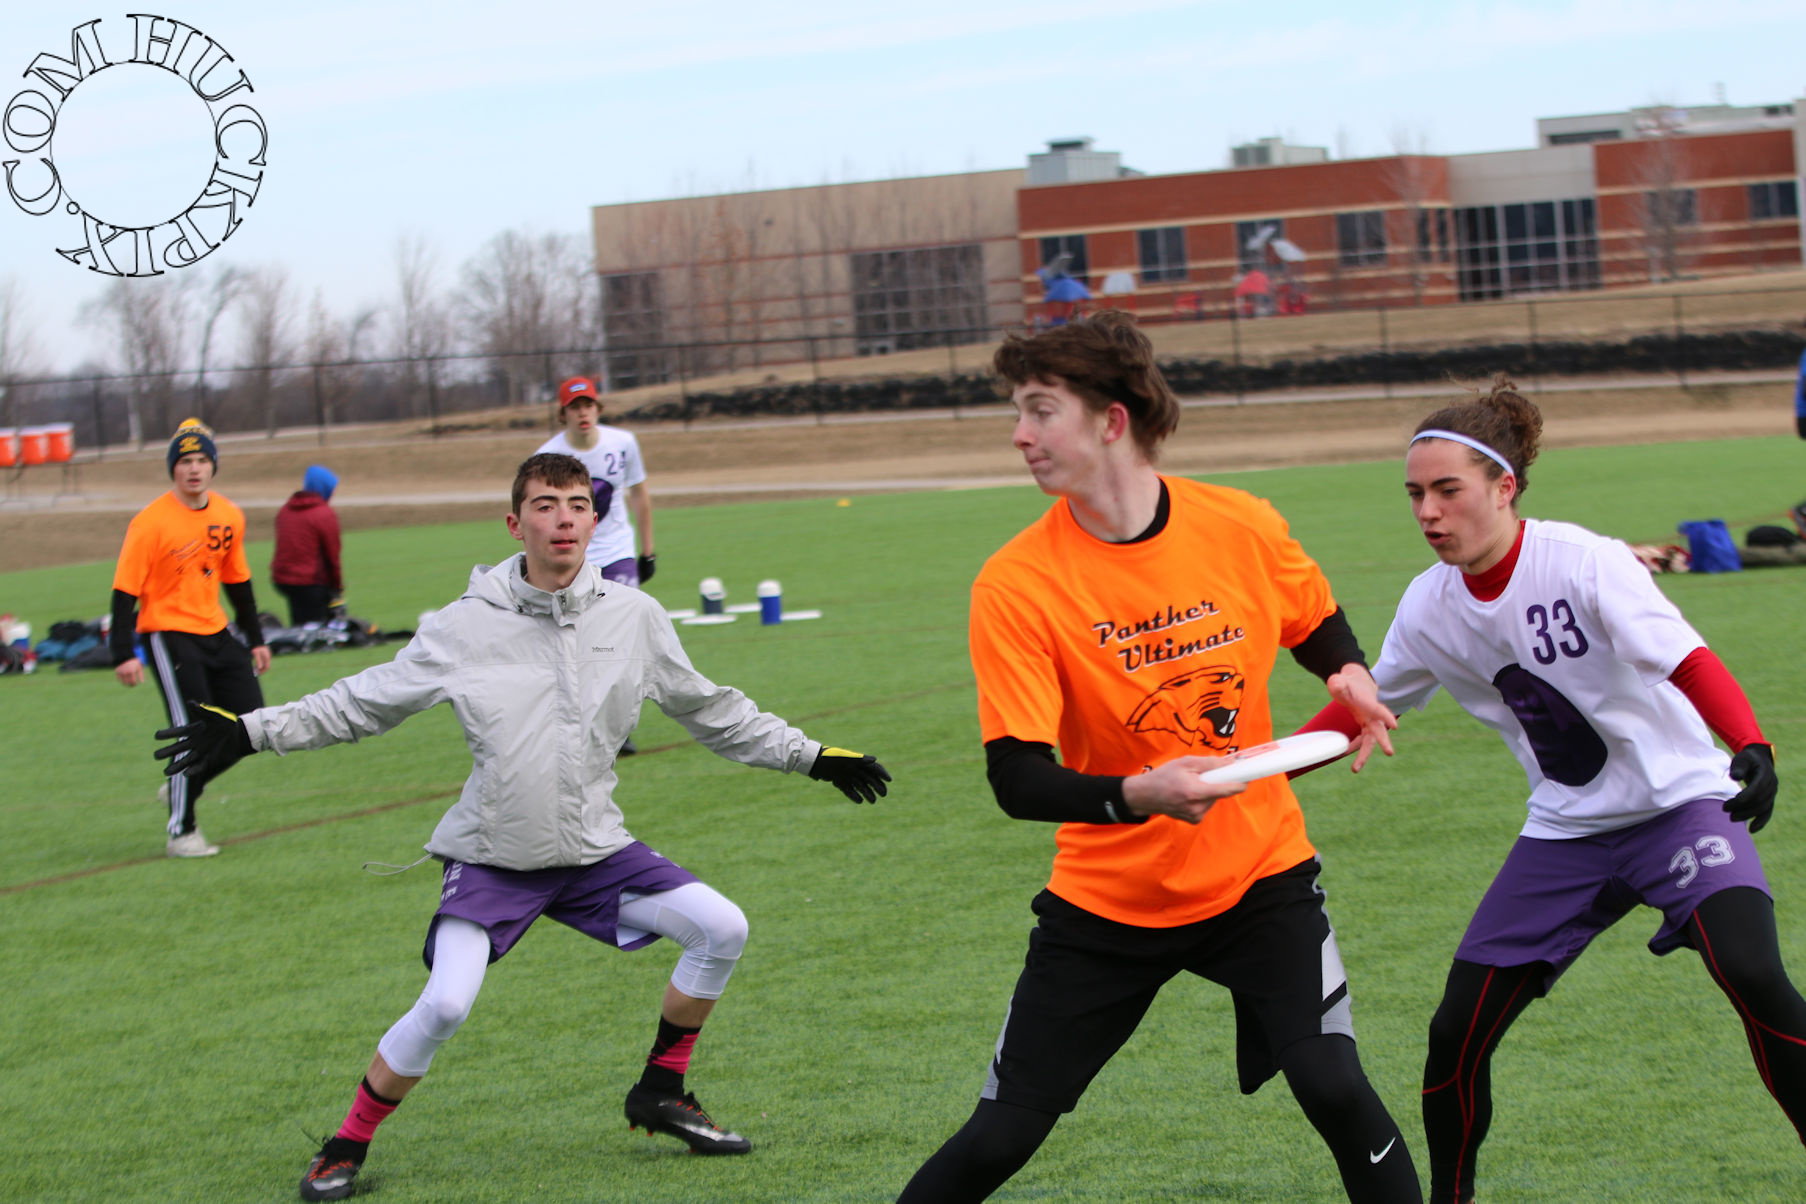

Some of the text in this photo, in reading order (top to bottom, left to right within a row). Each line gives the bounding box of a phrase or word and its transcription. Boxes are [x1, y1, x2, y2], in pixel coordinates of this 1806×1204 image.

[207, 526, 234, 551] 58
[1092, 600, 1219, 648] Panther
[1527, 598, 1589, 665] 33
[1117, 625, 1245, 672] Ultimate
[1668, 835, 1736, 889] 33
